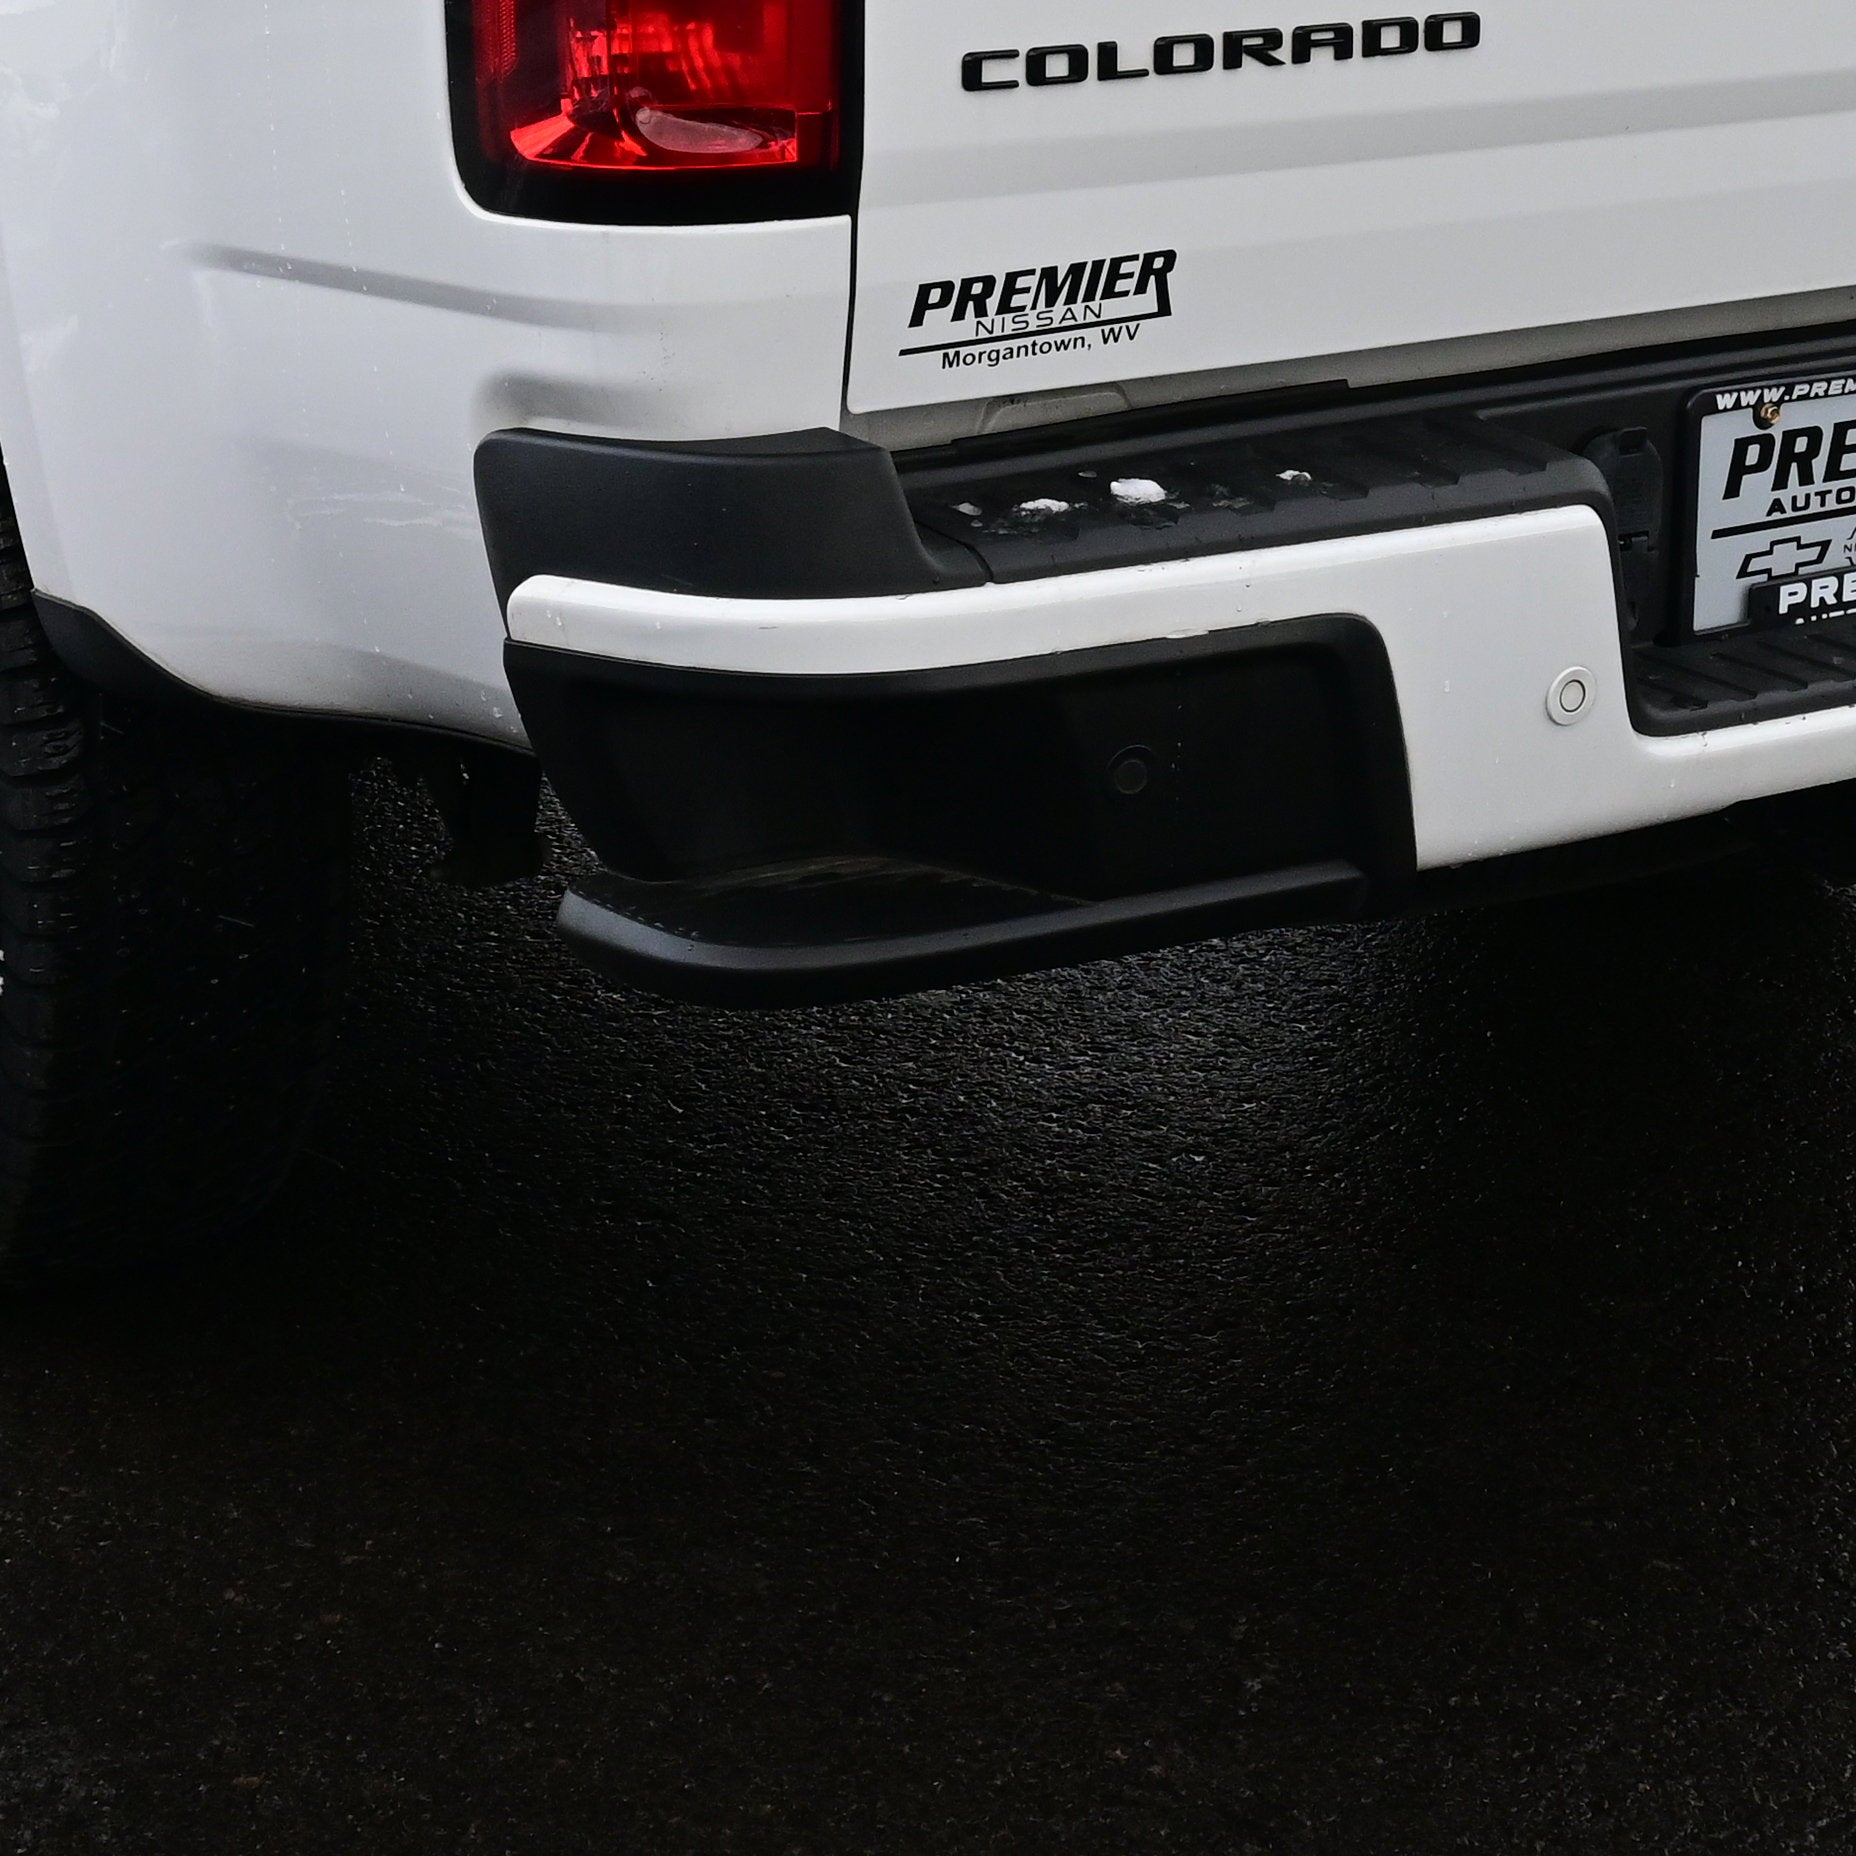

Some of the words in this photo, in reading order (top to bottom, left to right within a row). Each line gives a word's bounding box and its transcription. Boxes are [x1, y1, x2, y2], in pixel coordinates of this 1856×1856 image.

[961, 11, 1481, 92] COLORADO
[907, 249, 1177, 328] PREMIER
[975, 302, 1102, 337] NISSAN
[942, 333, 1091, 369] Morgantown,
[1101, 323, 1140, 345] WV
[1766, 485, 1856, 517] AUTO
